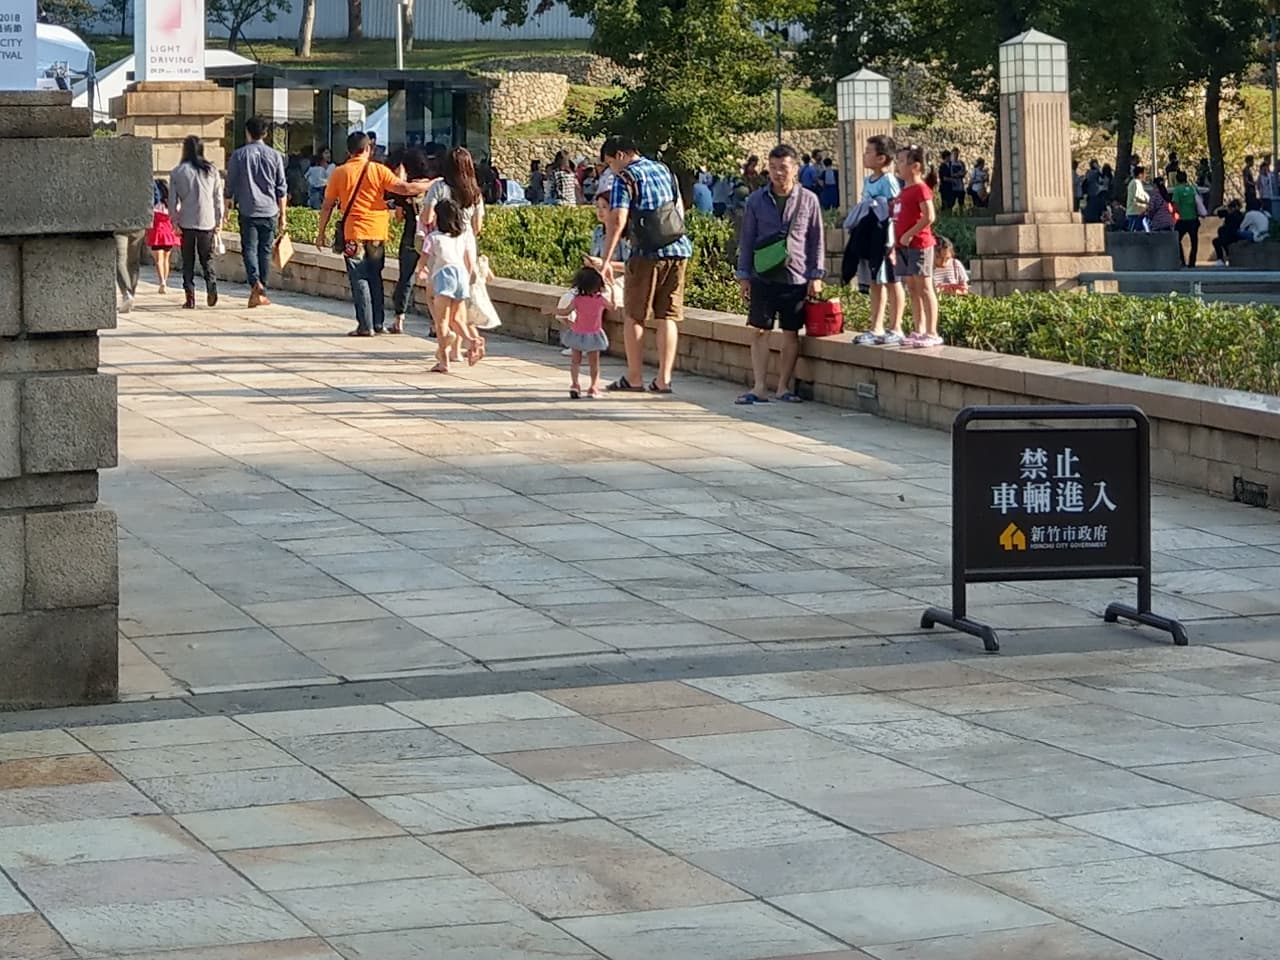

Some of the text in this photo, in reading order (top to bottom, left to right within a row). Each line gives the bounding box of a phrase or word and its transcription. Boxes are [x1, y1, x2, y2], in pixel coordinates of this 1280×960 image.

[0, 13, 21, 22] 2018
[0, 38, 24, 48] CITY
[150, 44, 181, 53] LIGHT
[150, 56, 194, 64] DRIVING
[1019, 447, 1081, 480] 禁止
[989, 480, 1118, 514] 車輛進入
[1030, 524, 1109, 543] 新竹市政府
